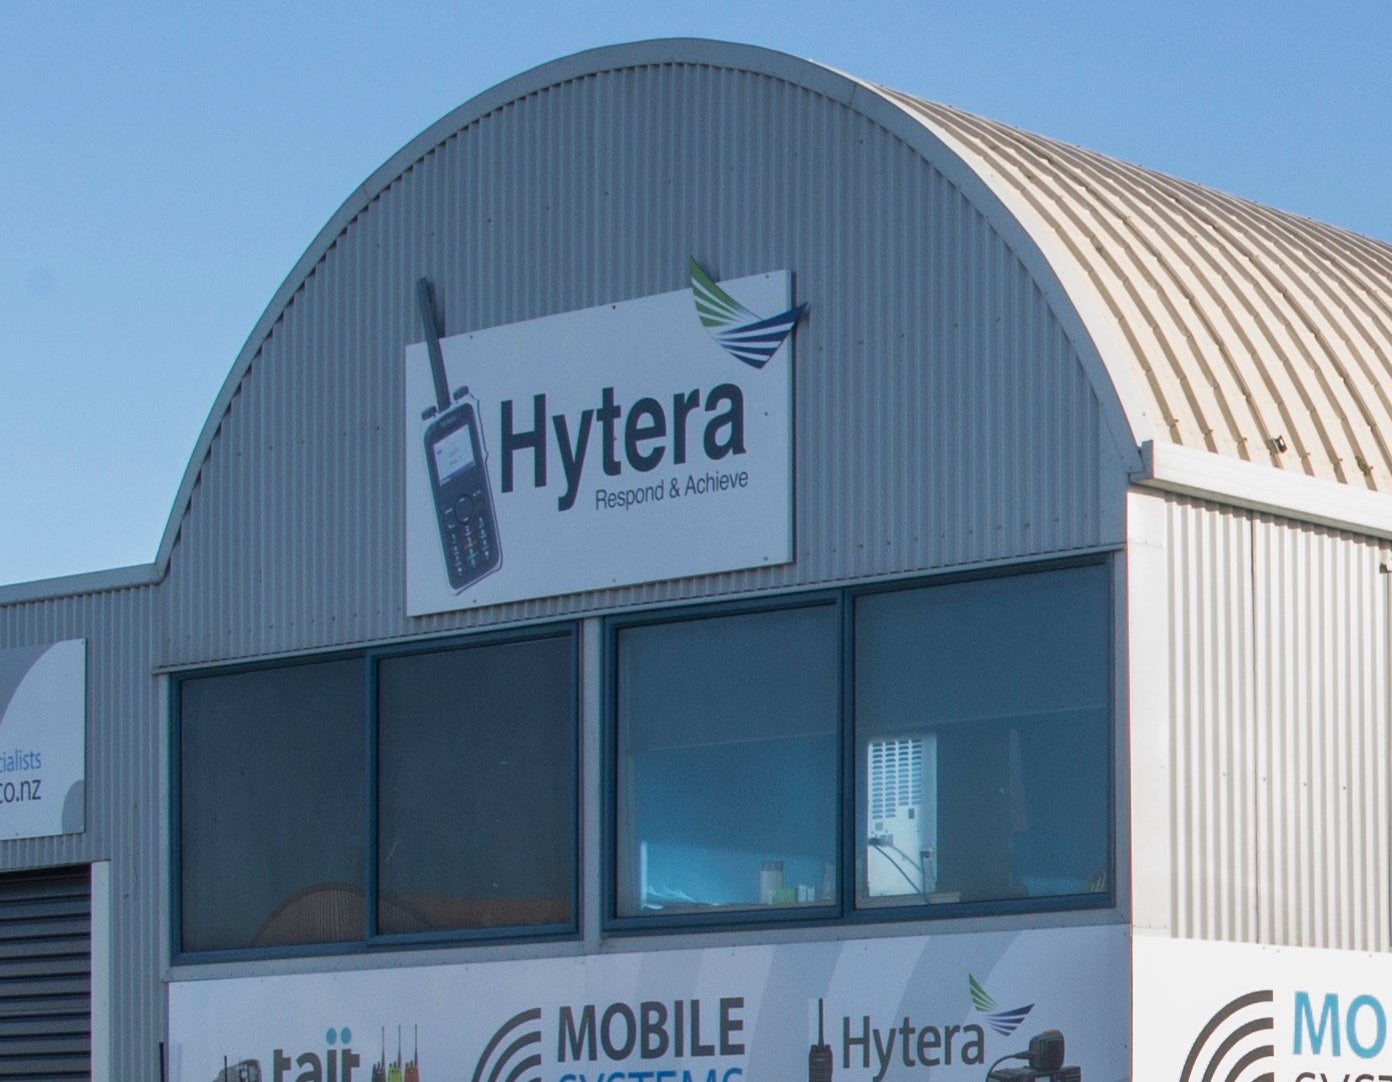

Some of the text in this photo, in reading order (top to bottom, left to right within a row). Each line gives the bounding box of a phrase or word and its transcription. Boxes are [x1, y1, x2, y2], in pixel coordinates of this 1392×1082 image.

[501, 382, 746, 511] Hytera
[595, 471, 749, 511] Respond & Achieve
[0, 748, 42, 773] ialists
[557, 997, 745, 1063] MOBILE
[843, 1015, 985, 1082] Hytera
